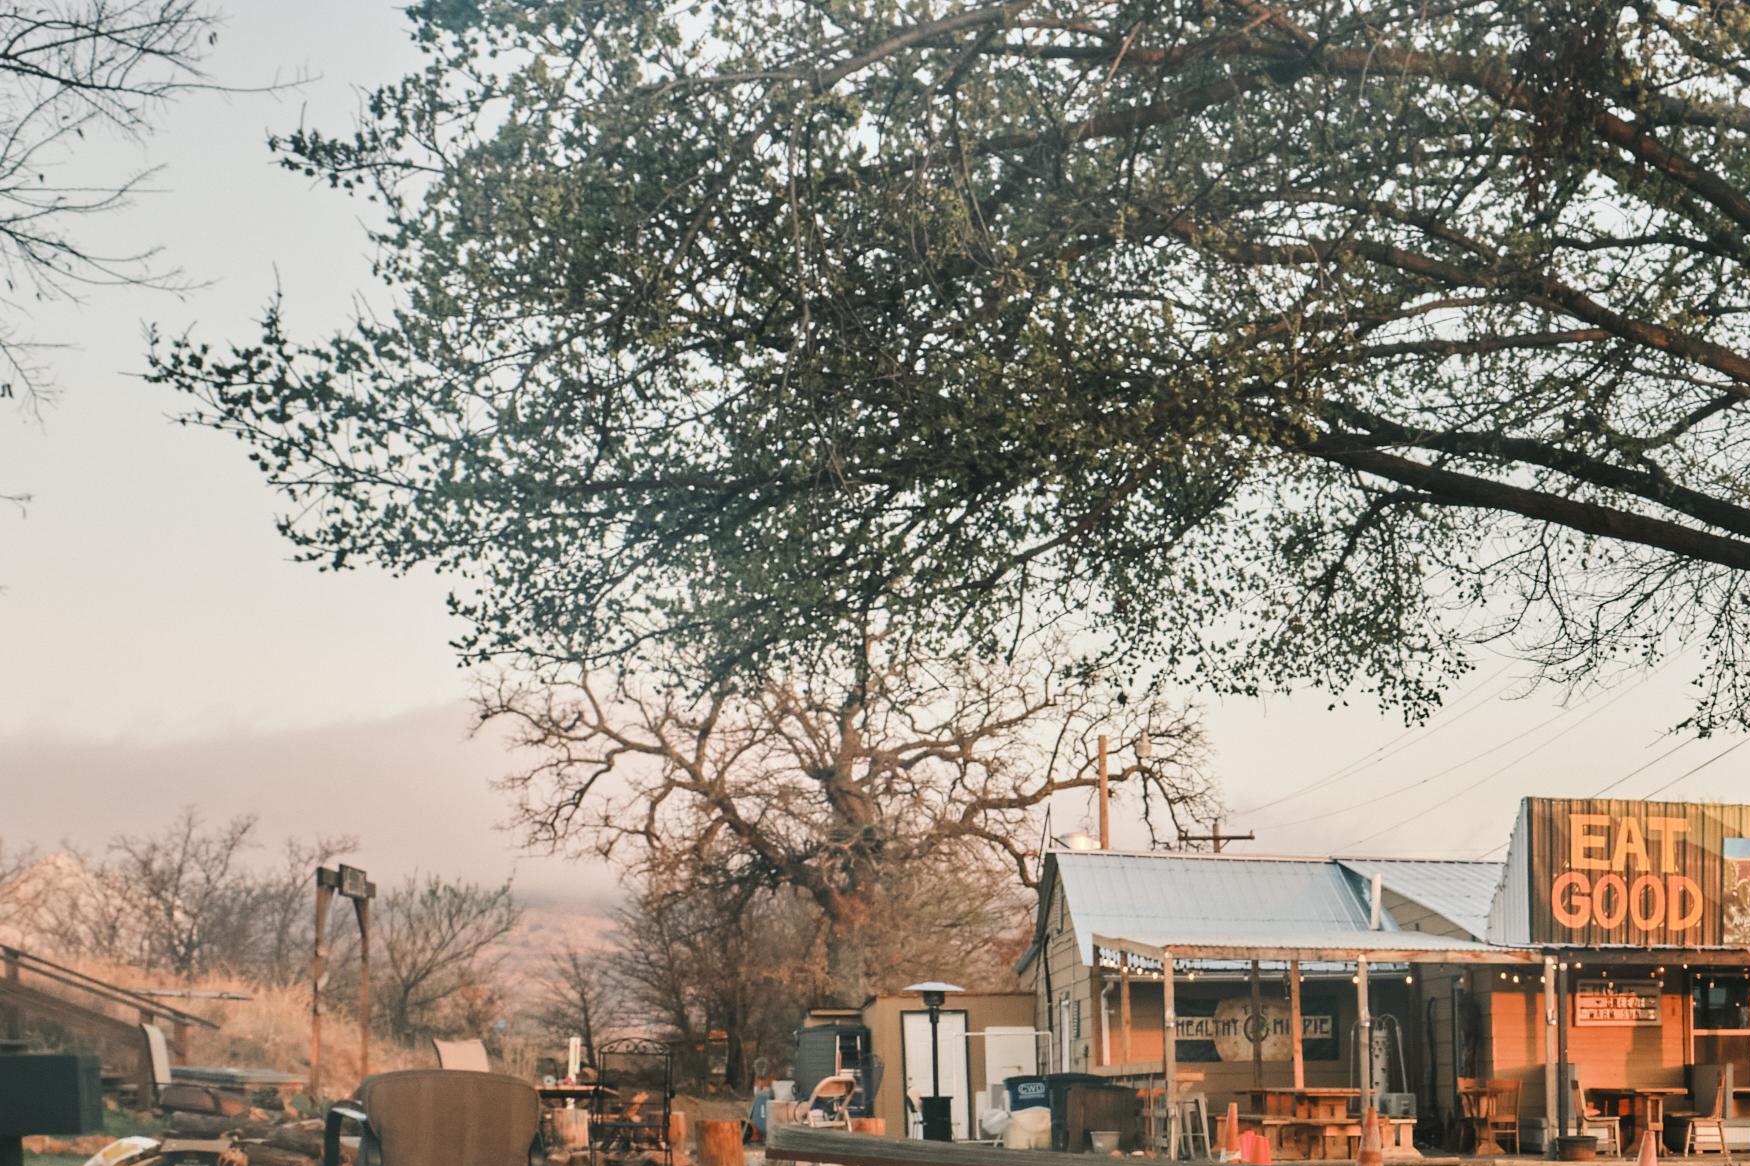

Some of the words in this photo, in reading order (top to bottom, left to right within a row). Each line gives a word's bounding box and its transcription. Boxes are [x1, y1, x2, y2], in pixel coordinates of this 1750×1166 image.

[1569, 814, 1688, 873] EAT
[1551, 871, 1703, 931] GOOD
[1175, 1017, 1239, 1038] HEALTHY
[1273, 1017, 1331, 1036] HIPIE
